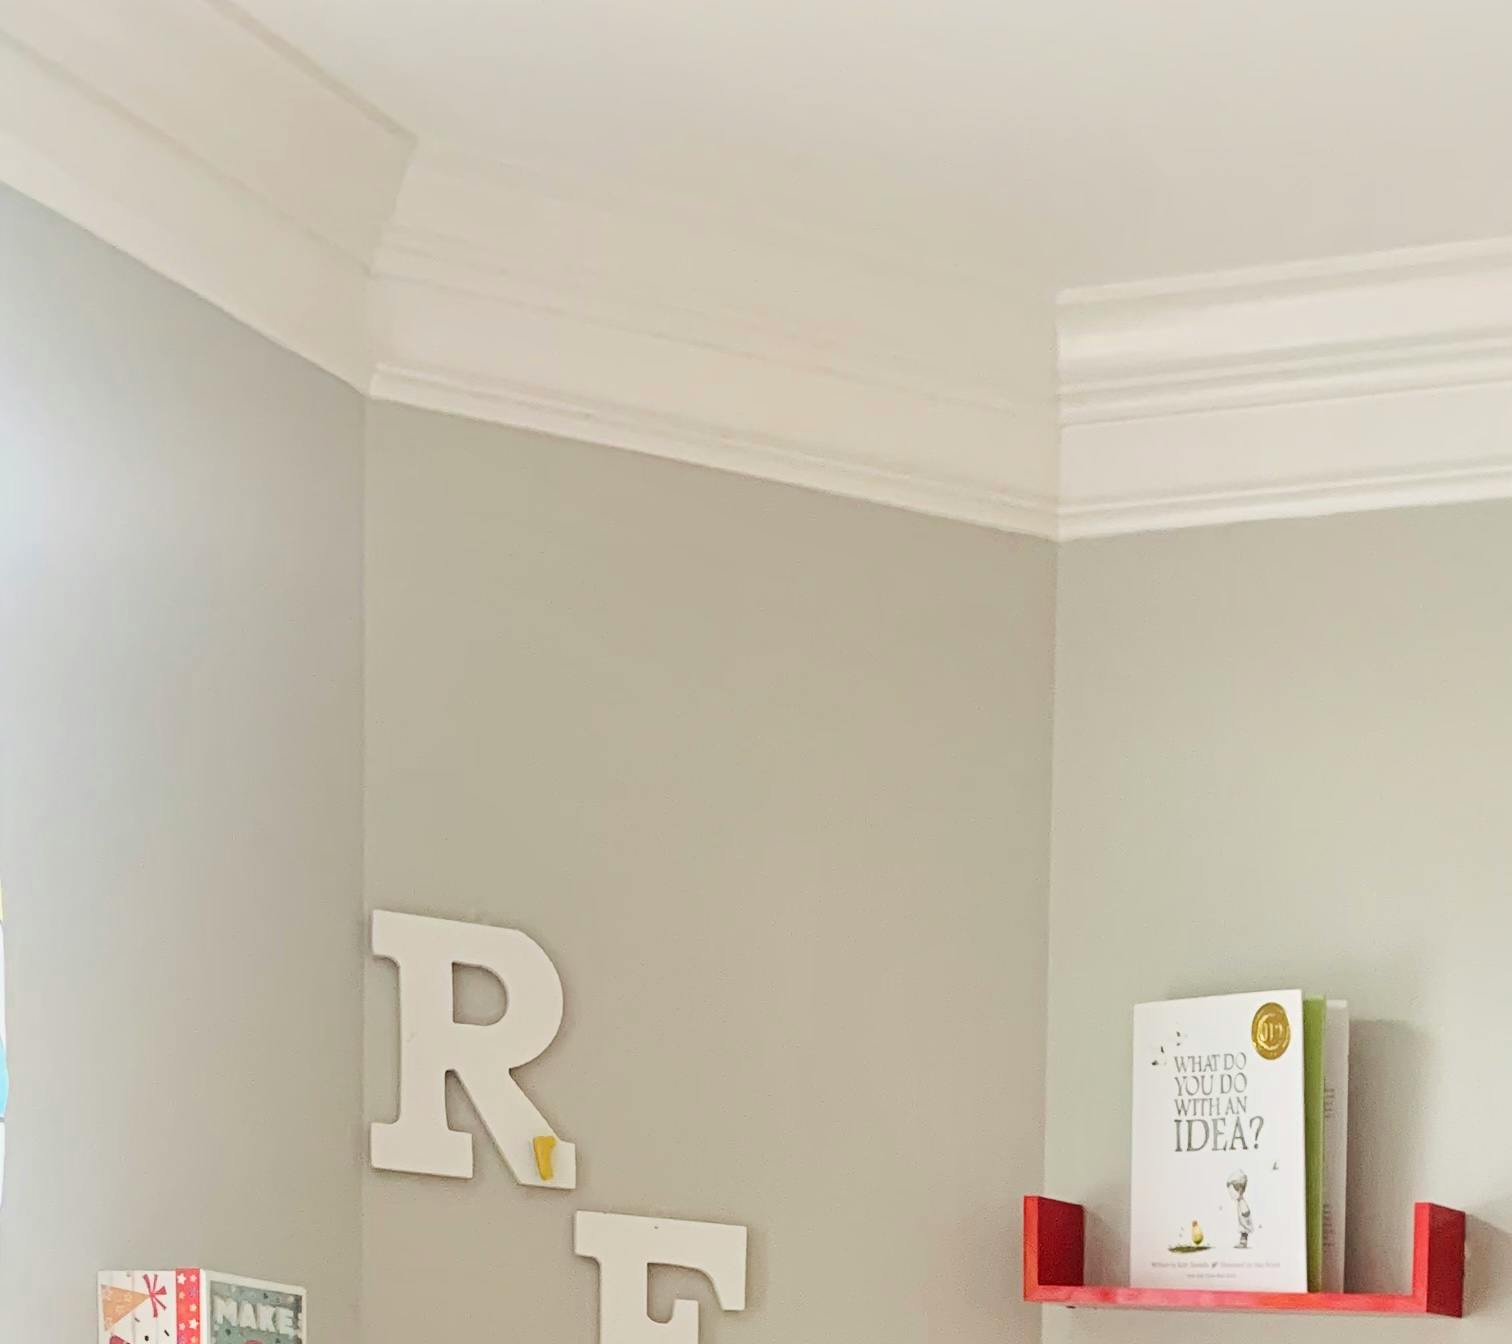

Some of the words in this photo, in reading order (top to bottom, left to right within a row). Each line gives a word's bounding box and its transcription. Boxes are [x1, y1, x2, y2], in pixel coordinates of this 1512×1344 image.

[1174, 1054, 1221, 1073] WHAT
[1223, 1051, 1248, 1071] DO
[1174, 1075, 1214, 1096] YOU
[1220, 1072, 1248, 1094] DO
[1174, 1098, 1221, 1116] WITH
[1224, 1096, 1248, 1116] AN
[1173, 1115, 1264, 1152] IDEA?
[213, 1295, 295, 1337] MAKE
